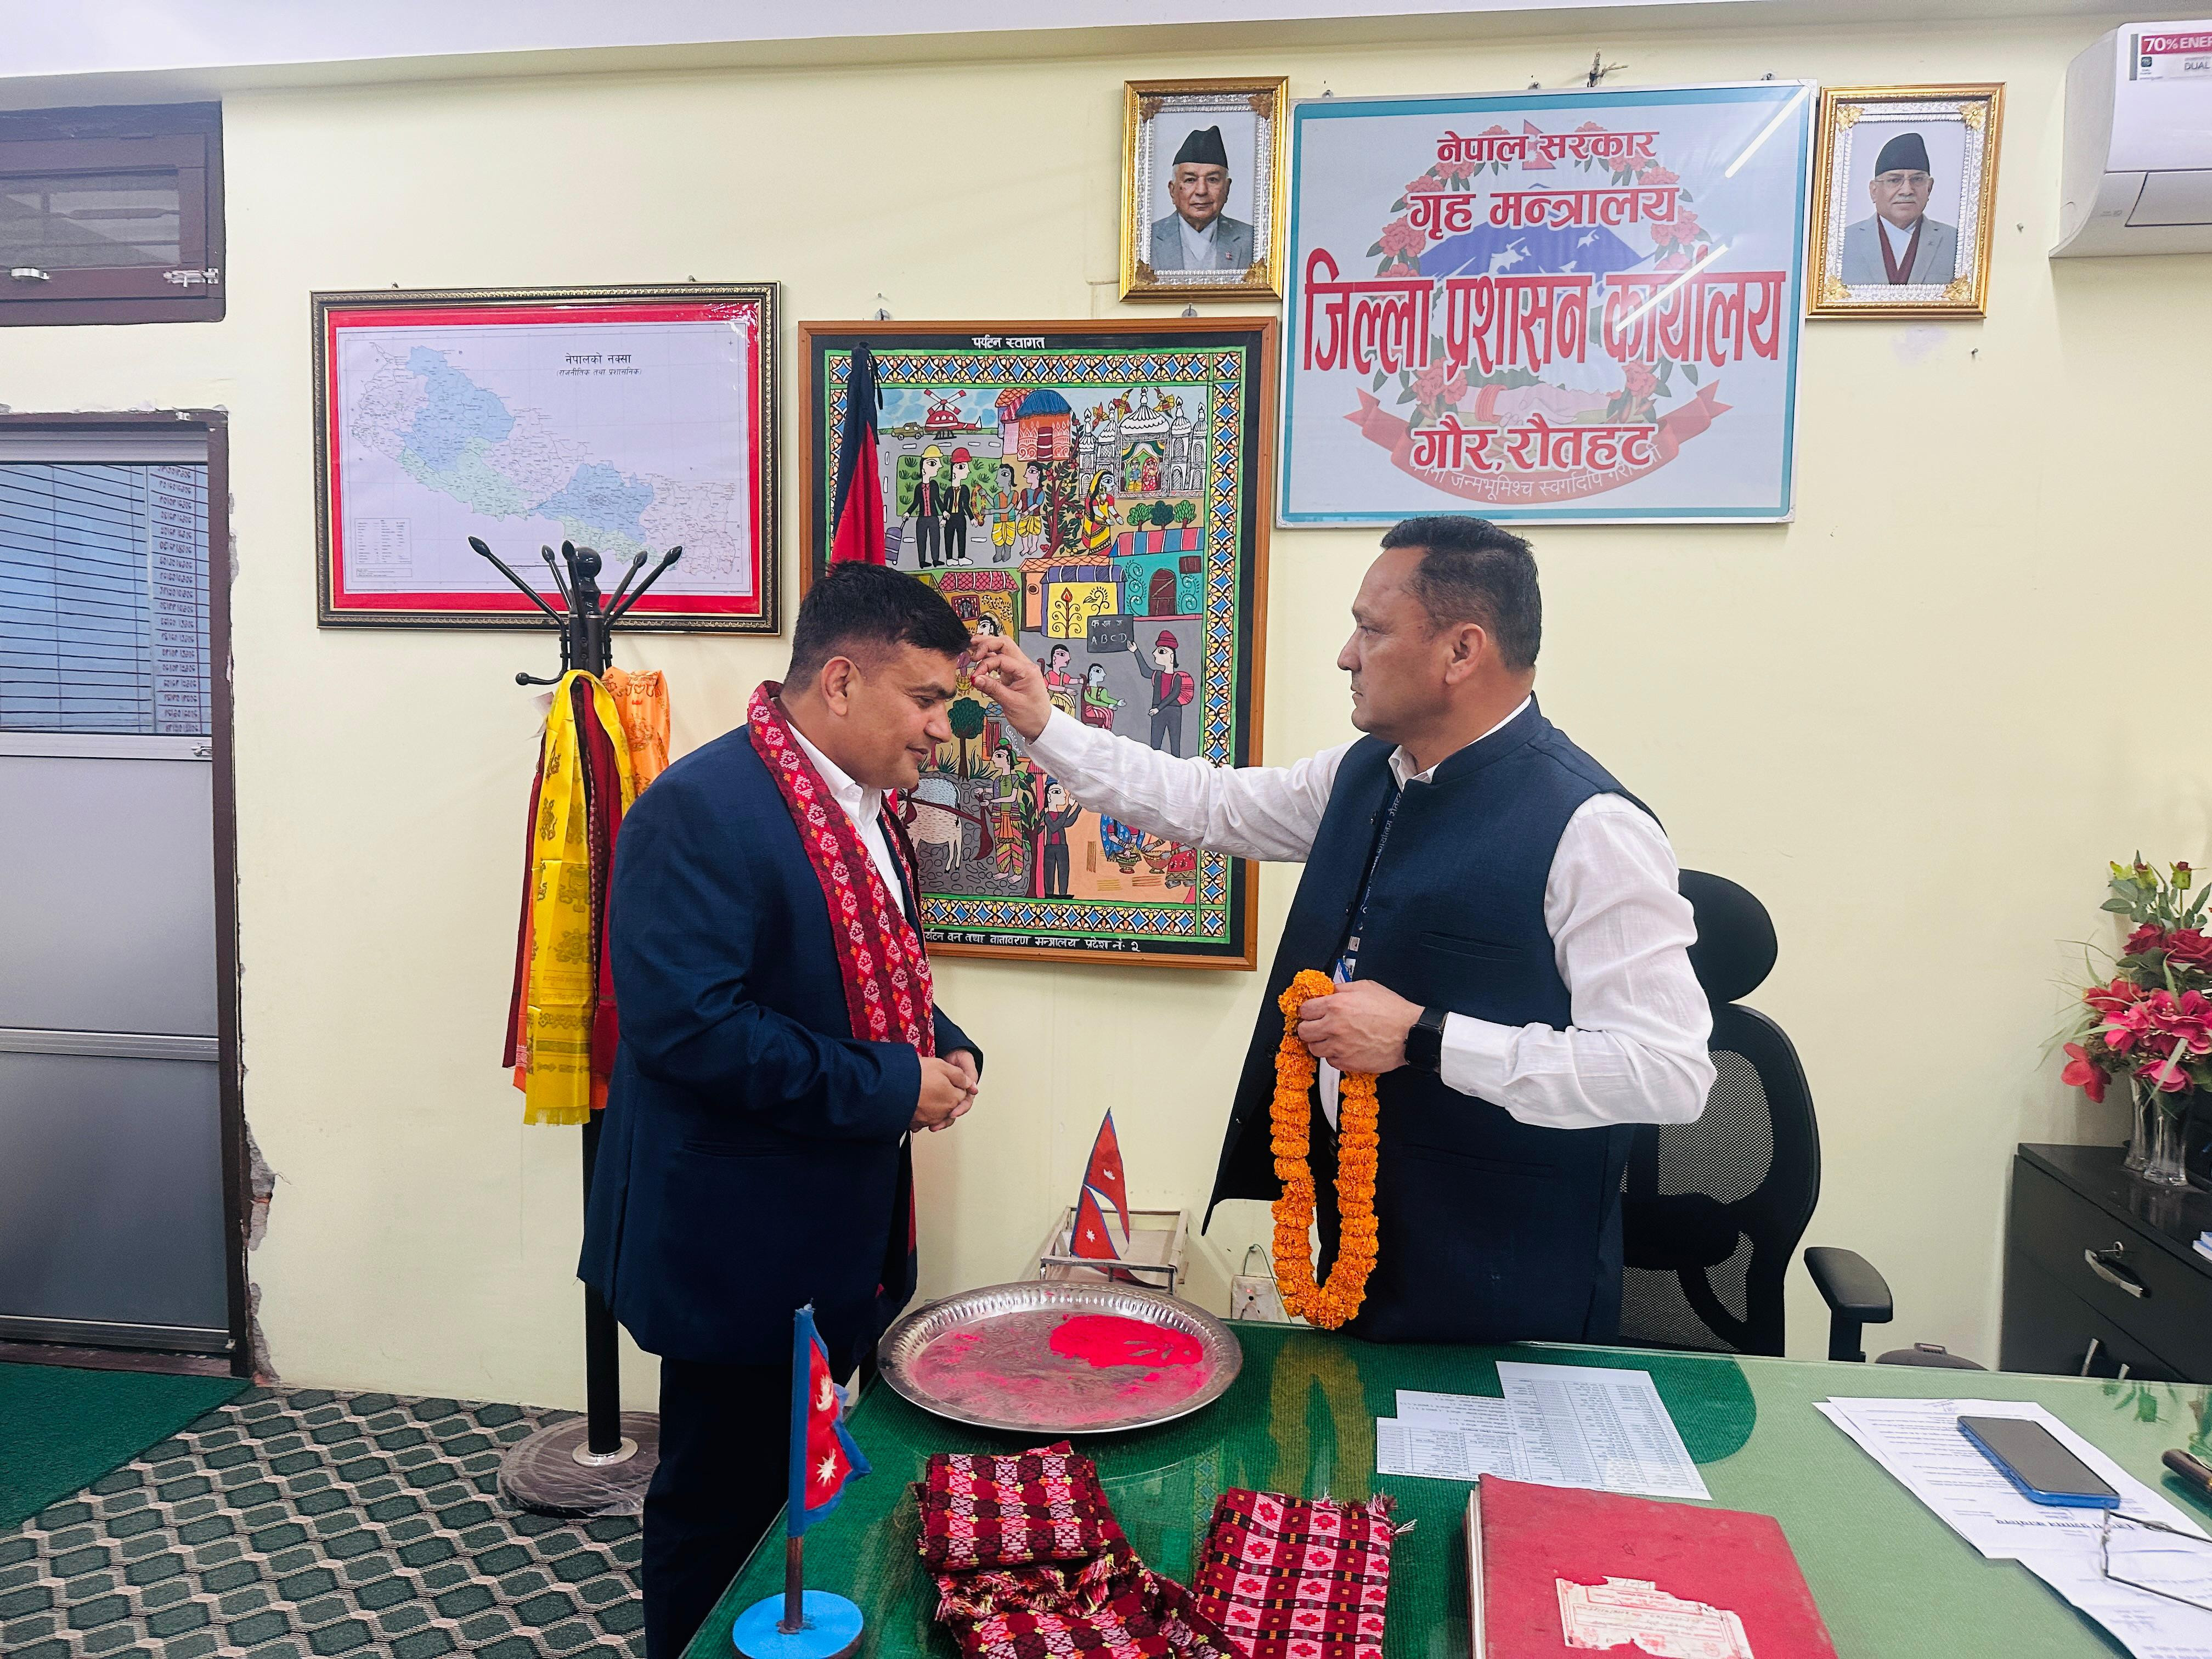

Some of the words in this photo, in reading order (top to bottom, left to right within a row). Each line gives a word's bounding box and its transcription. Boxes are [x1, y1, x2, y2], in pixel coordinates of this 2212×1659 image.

[2143, 36, 2179, 53] 70%
[2185, 61, 2210, 71] DUAL
[1437, 130, 1526, 163] नेपाल
[1536, 132, 1660, 161] सरकार
[1409, 192, 1476, 240] गृह
[1490, 187, 1680, 228] मन्त्रालय
[1304, 248, 1436, 371] जिल्ला
[1447, 273, 1589, 381] प्रशासन
[1605, 245, 1787, 366] कार्यालय
[1005, 337, 1045, 349] स्वागत
[565, 352, 602, 364] नेपालको
[607, 354, 631, 364] नक्सा
[1091, 619, 1099, 628] क
[1091, 636, 1097, 645] A
[1101, 634, 1108, 644] B
[1119, 633, 1127, 643] D
[947, 932, 962, 942] वन
[964, 933, 985, 944] तथा
[990, 934, 1031, 945] वातावरण
[1034, 936, 1080, 947] मन्त्रालय
[1084, 936, 1111, 950] प्रदेश
[1131, 941, 1141, 952] २
